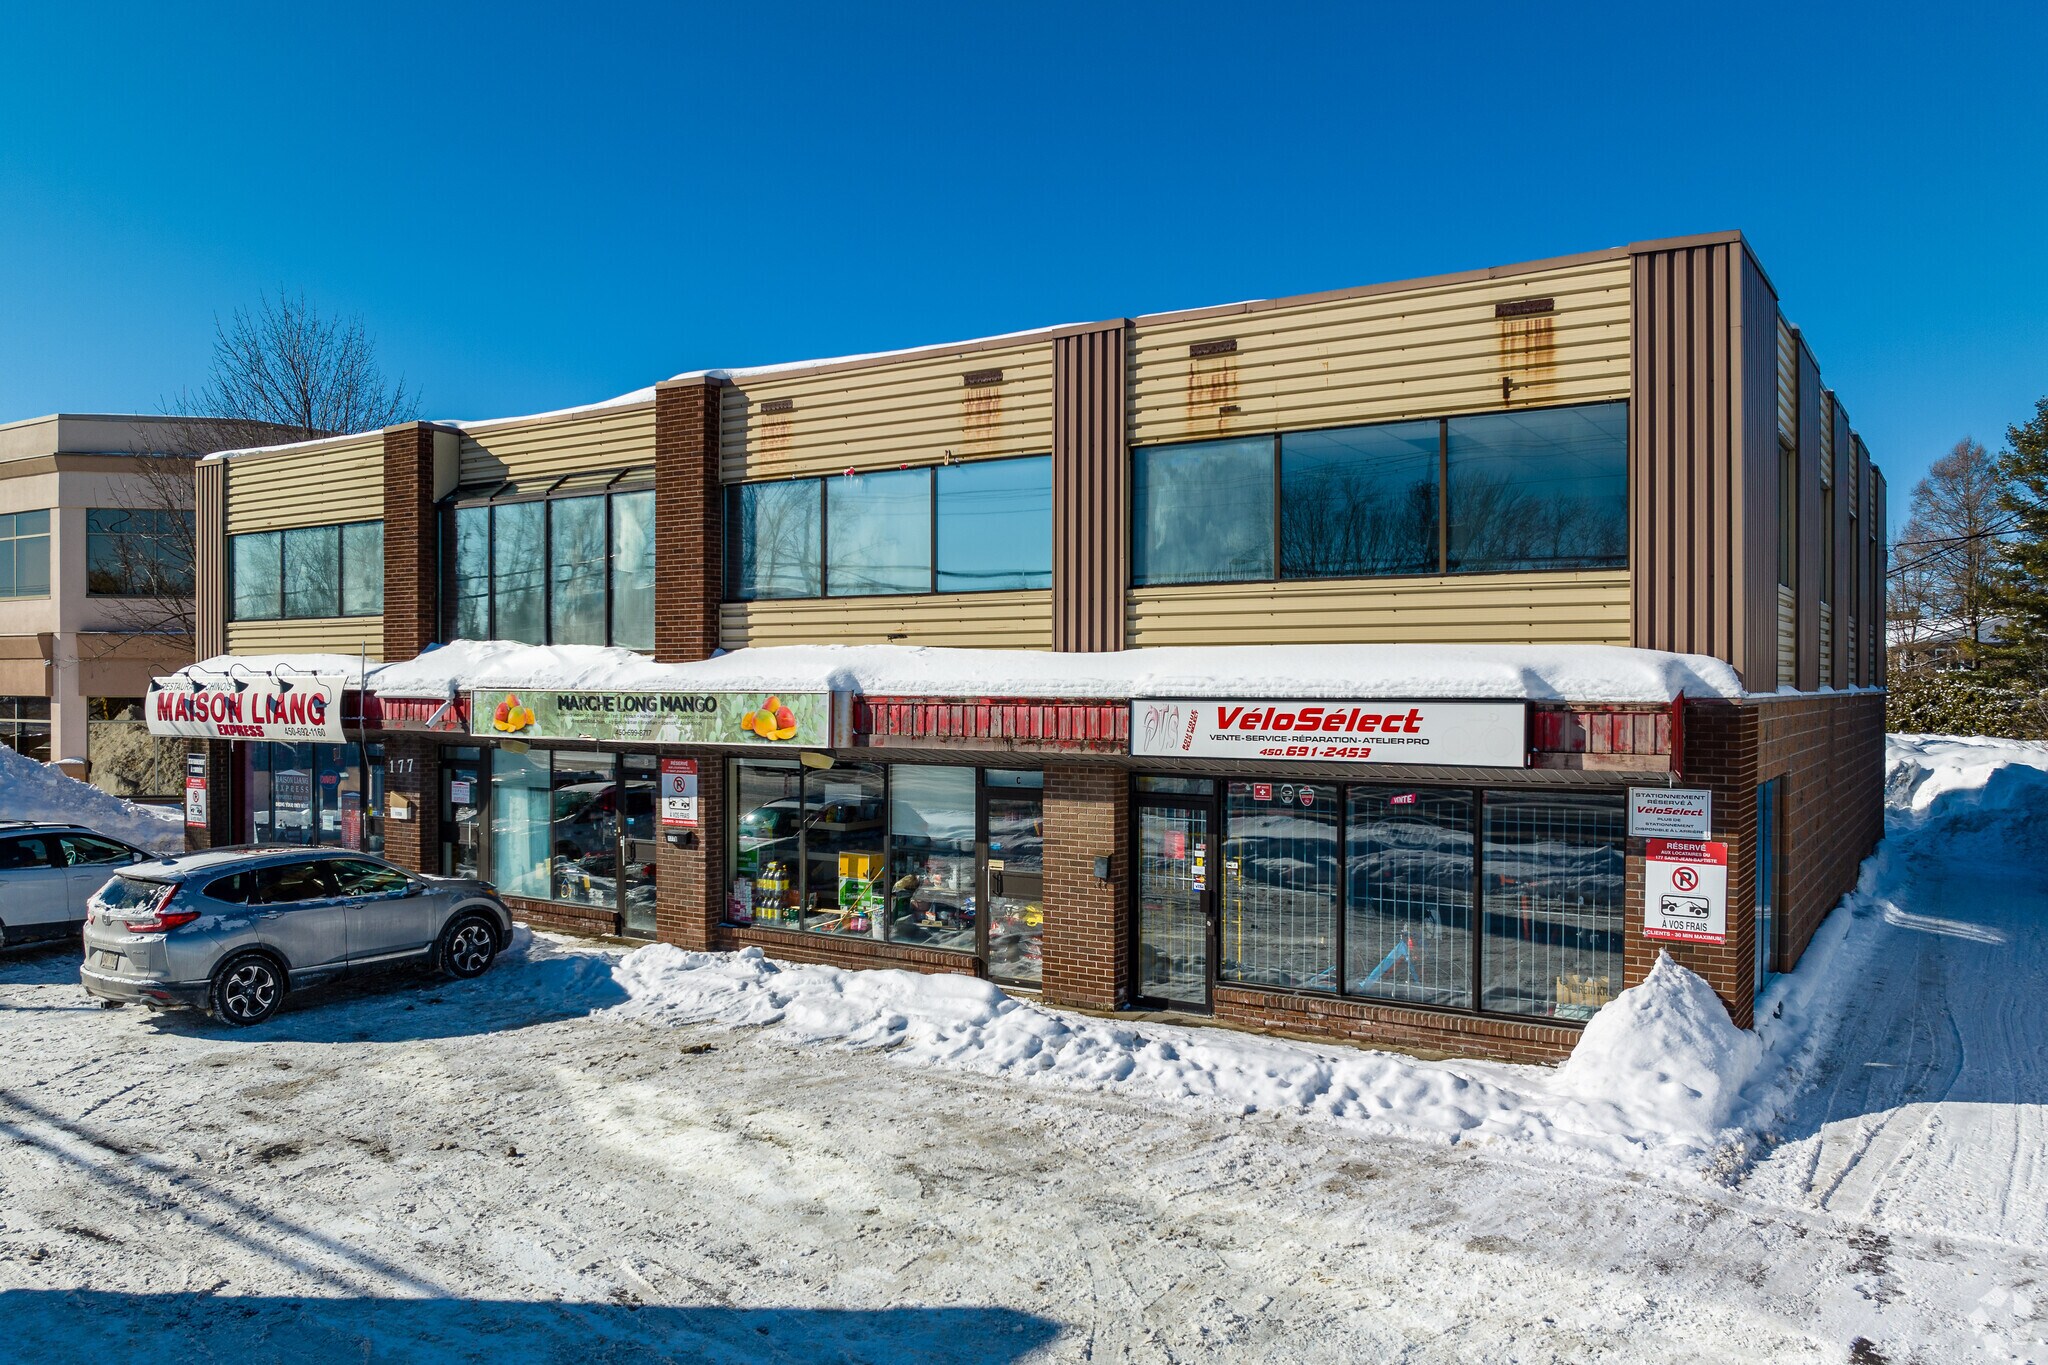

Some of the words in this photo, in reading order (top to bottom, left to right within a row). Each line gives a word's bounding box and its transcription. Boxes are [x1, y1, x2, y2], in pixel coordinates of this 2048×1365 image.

[157, 692, 243, 723] MAISON
[252, 692, 326, 725] LIANG
[617, 695, 658, 712] LONG
[661, 696, 718, 713] MANGO
[1217, 706, 1424, 733] VéloSélect
[217, 724, 265, 737] EXPRESS
[284, 727, 326, 737] 450-692-1160
[1362, 737, 1405, 745] ATELIER
[389, 758, 413, 773] 177
[1016, 776, 1021, 784] C
[1635, 792, 1706, 800] STATIONNEMENT
[1637, 806, 1704, 816] VéloSélect
[1666, 842, 1707, 851] RÉSERVÉ
[1662, 918, 1667, 928] À
[1669, 920, 1684, 930] VOS
[1685, 921, 1708, 932] FRAIS
[1646, 929, 1671, 937] CLIENTS
